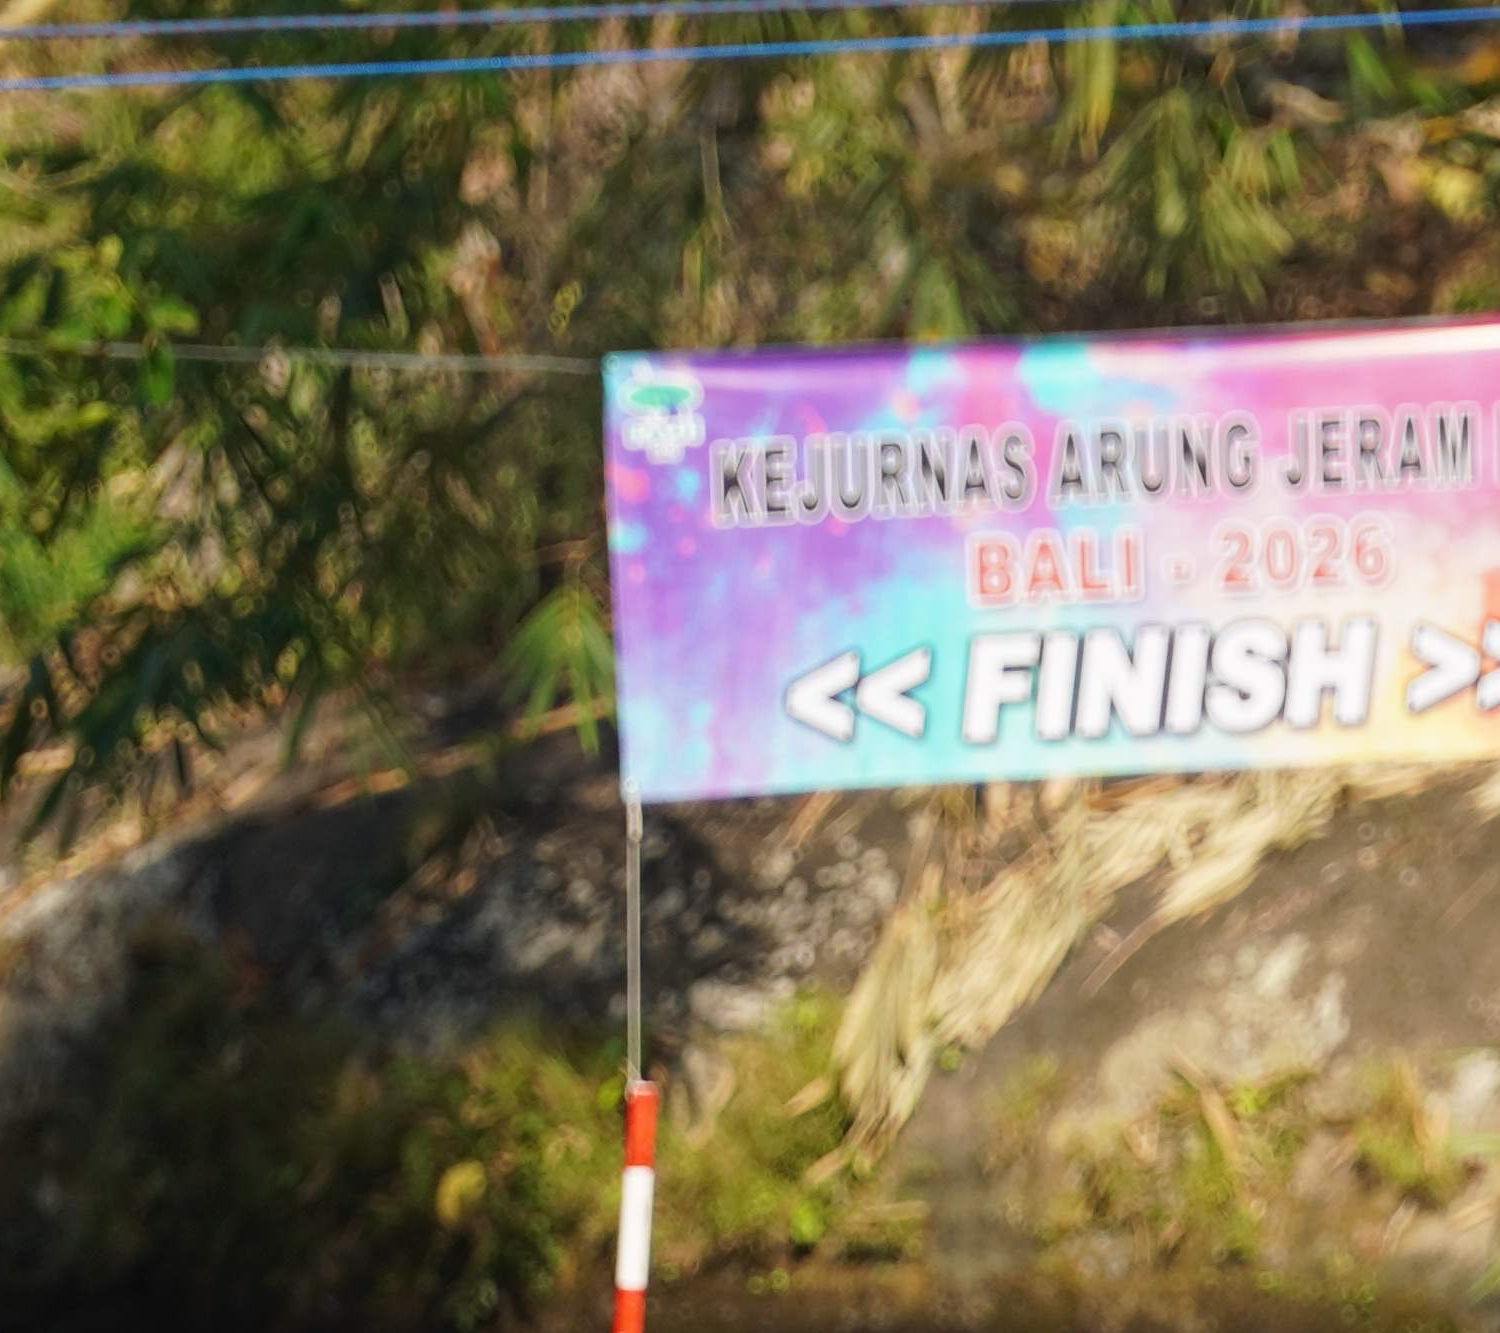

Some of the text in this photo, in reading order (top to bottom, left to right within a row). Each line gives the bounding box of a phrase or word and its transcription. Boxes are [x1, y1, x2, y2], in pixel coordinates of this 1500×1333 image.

[713, 427, 1033, 524] KEJURNAS
[1049, 414, 1259, 504] ARUNG
[1281, 404, 1479, 491] JERAM
[974, 533, 1140, 602] BALI
[1216, 522, 1389, 592] 2026
[961, 618, 1378, 744] FINISH
